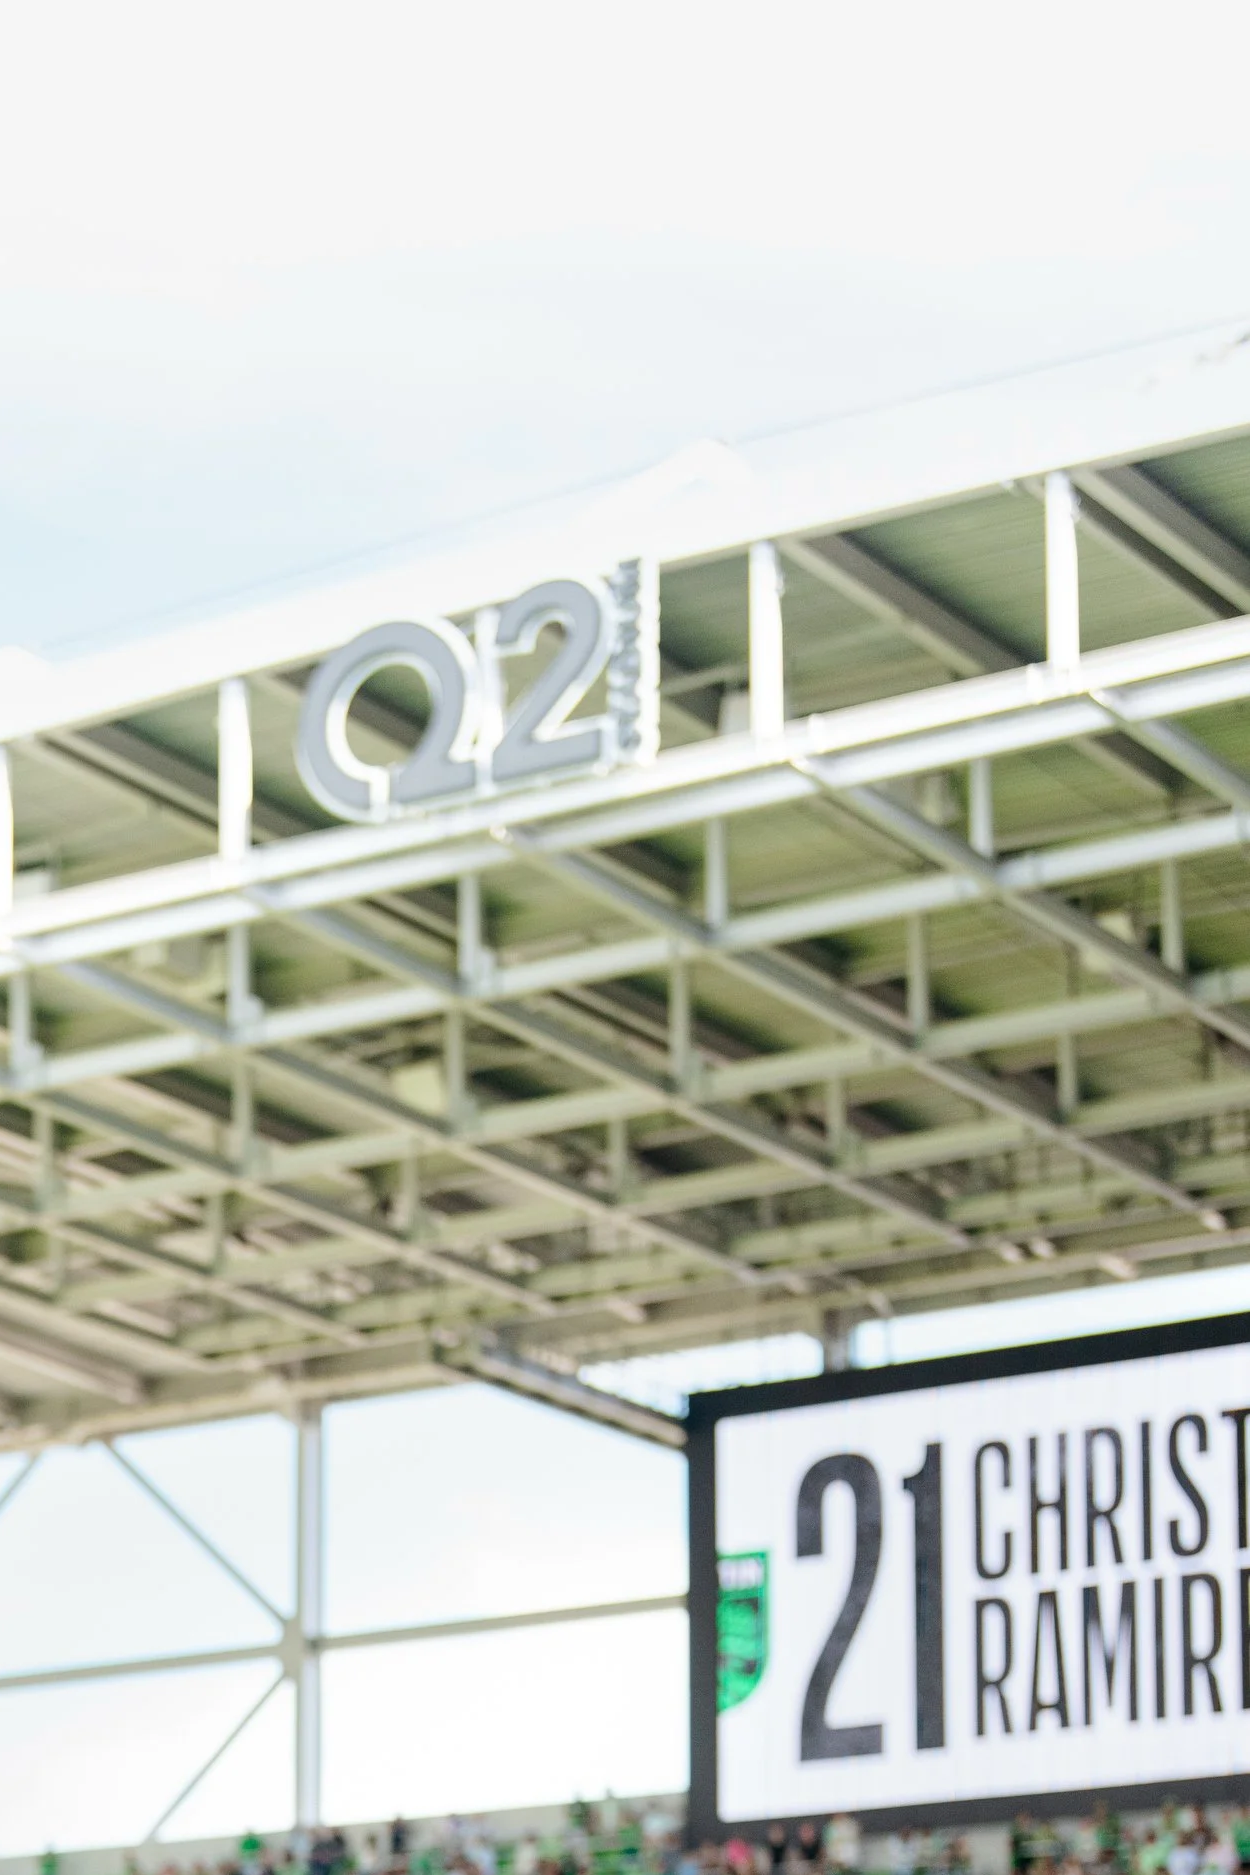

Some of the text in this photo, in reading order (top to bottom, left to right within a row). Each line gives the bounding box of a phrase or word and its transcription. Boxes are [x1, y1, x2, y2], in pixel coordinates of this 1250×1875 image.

[297, 578, 606, 816] Q2
[795, 1441, 946, 1762] 21
[973, 1408, 1250, 1581] CHRIST
